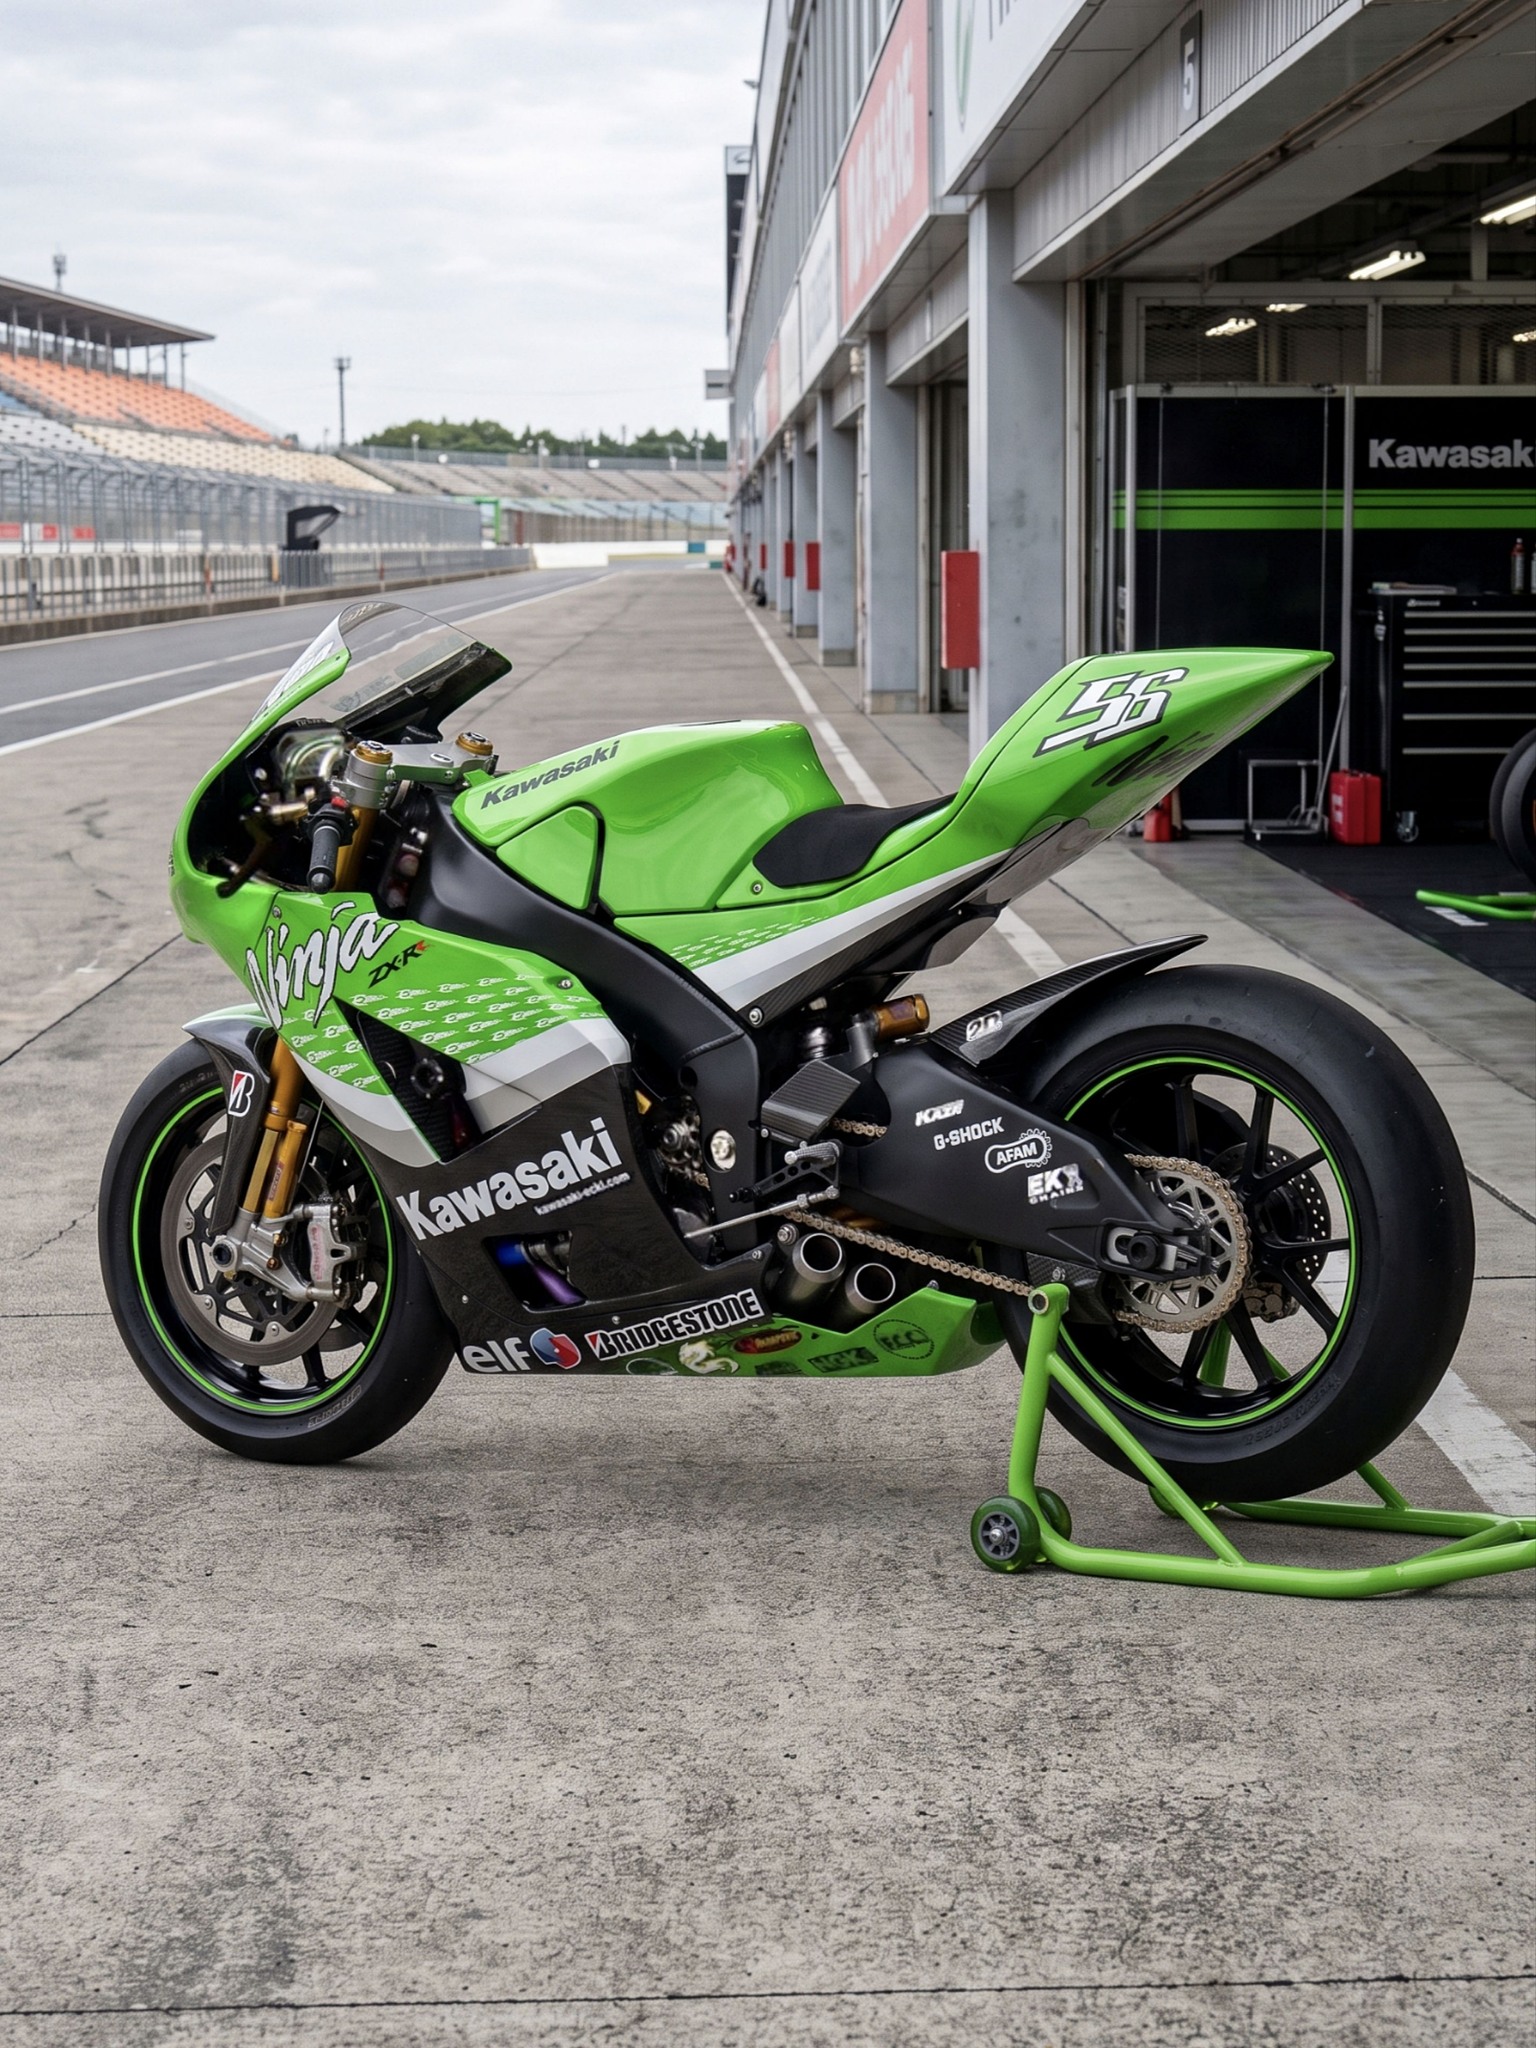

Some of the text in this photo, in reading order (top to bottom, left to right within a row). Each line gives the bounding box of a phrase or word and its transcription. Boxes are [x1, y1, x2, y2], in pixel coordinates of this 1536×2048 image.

[1183, 38, 1195, 111] 5
[1369, 438, 1536, 469] Kawasak
[1032, 667, 1190, 758] 56
[480, 740, 620, 810] Kawasaki
[246, 901, 400, 1030] Ninja
[396, 1116, 622, 1241] Kawasaki
[996, 1142, 1038, 1165] AFAM
[462, 1336, 532, 1373] elf
[584, 1288, 766, 1361] BRIDGESTONE
